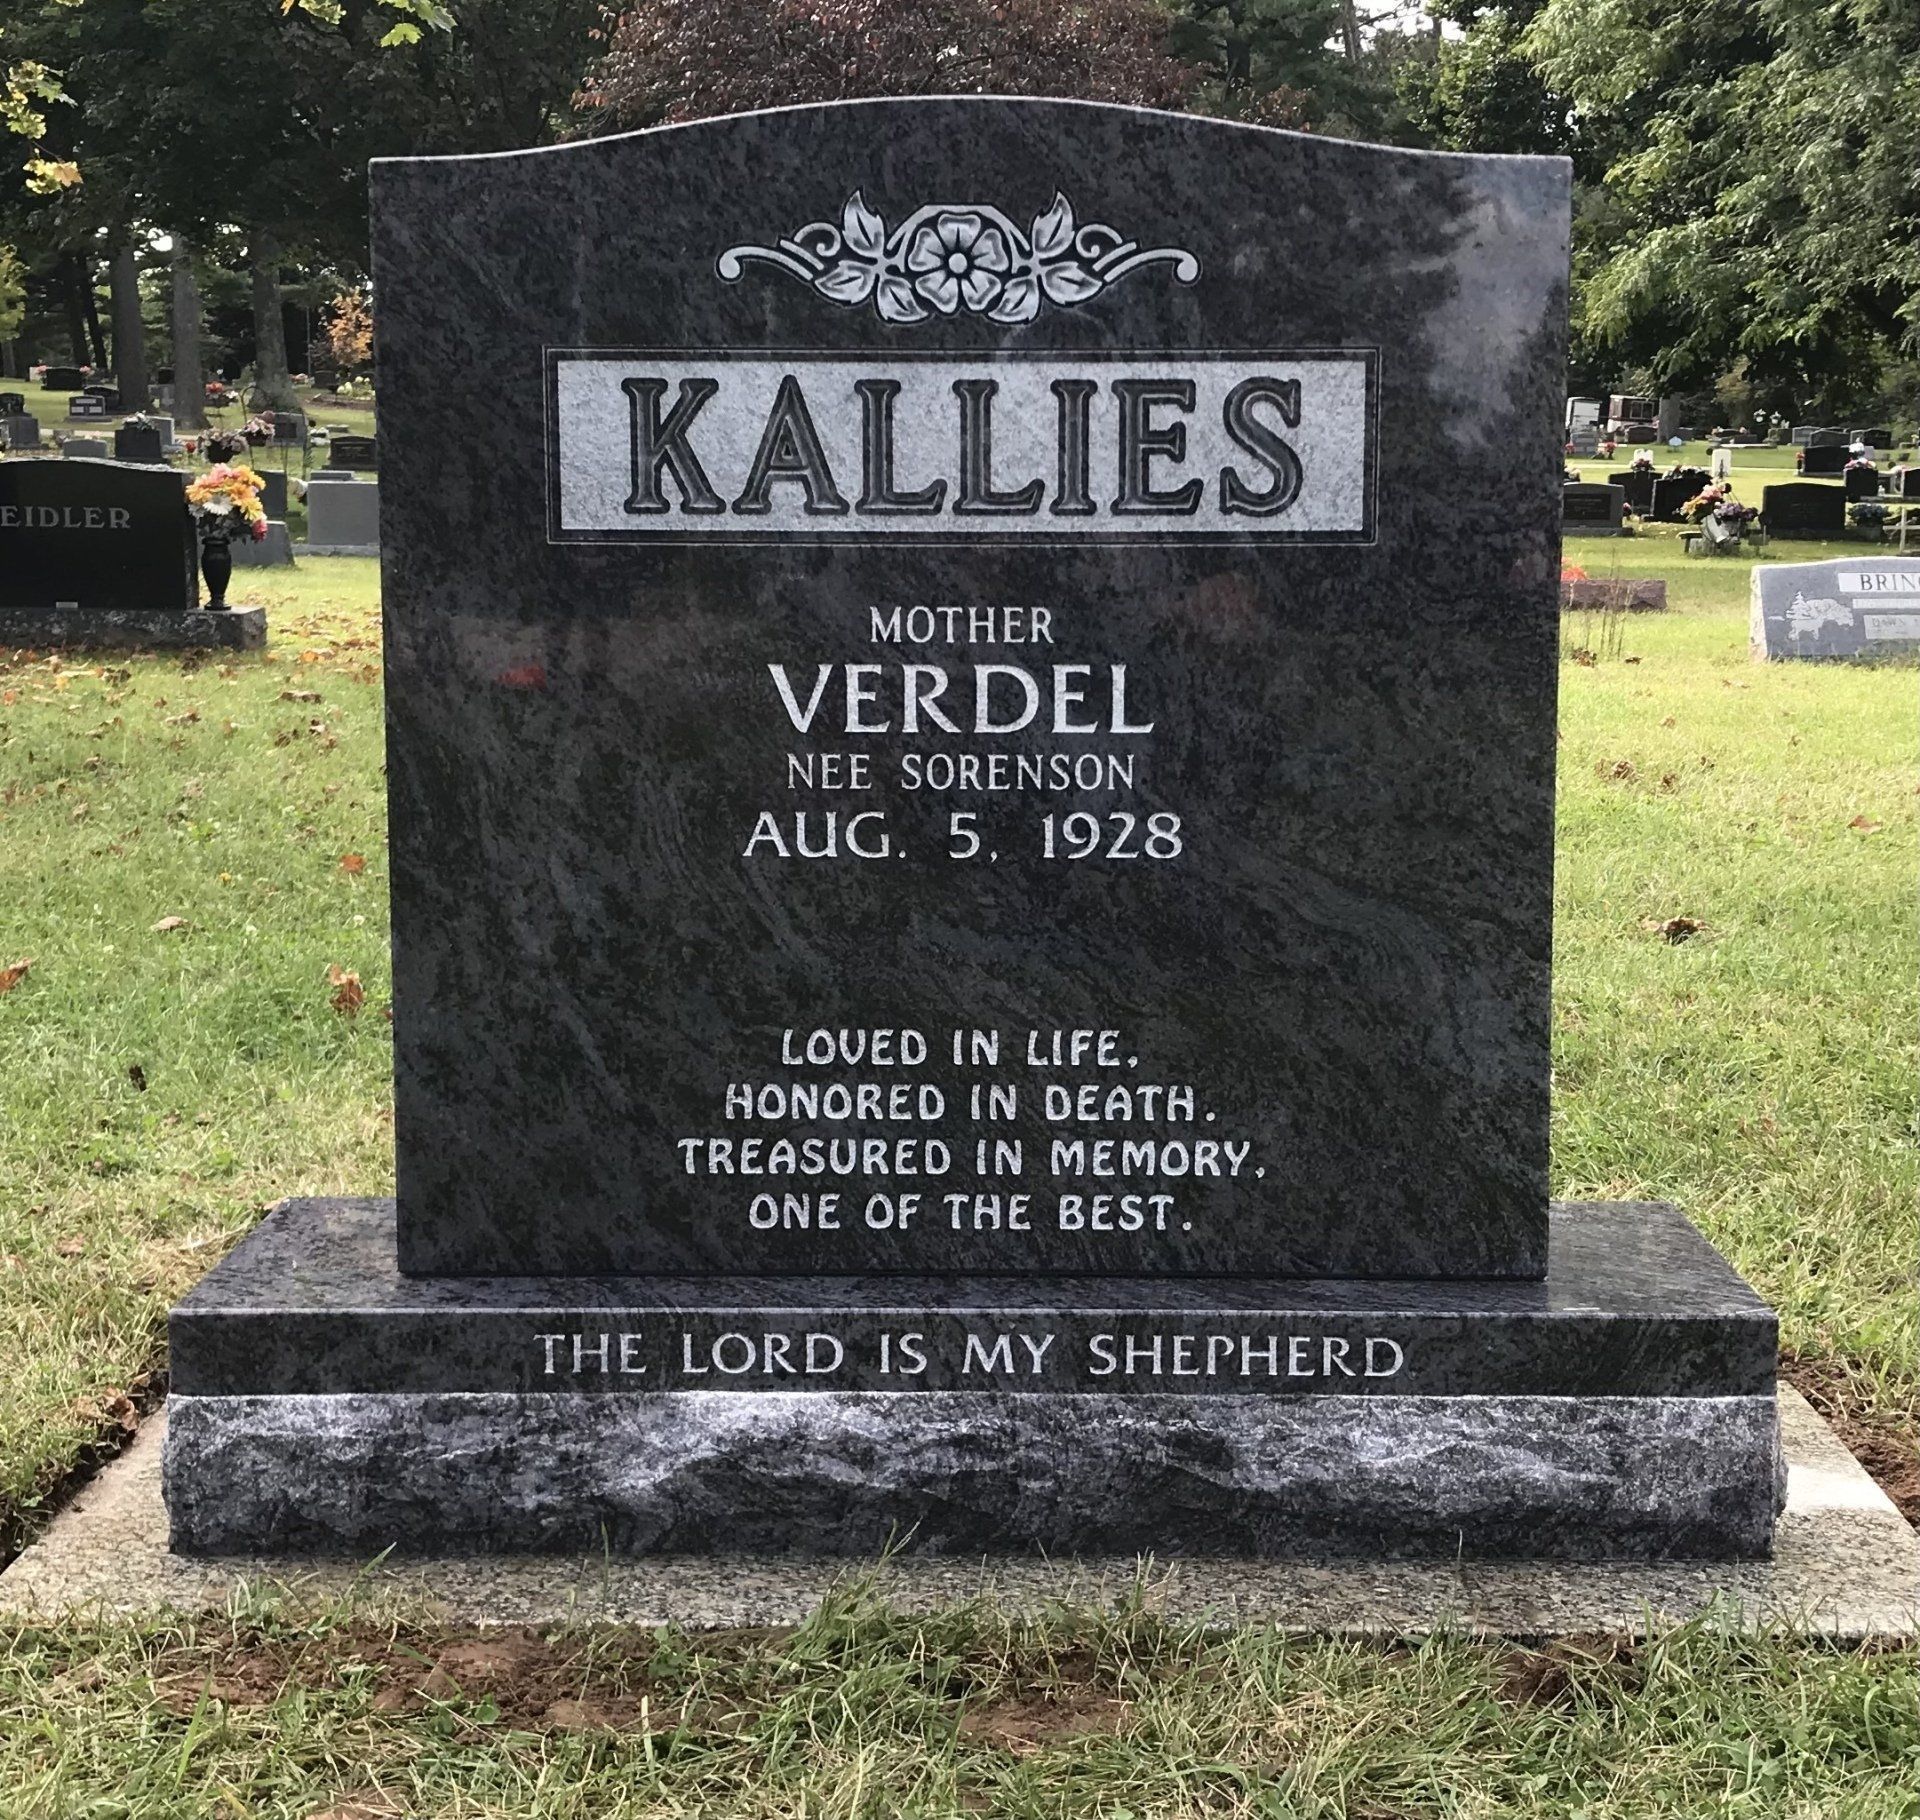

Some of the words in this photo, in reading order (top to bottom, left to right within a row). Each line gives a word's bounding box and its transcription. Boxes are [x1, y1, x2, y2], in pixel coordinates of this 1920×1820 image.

[620, 375, 1304, 517] KALLIES
[1860, 574, 1920, 590] BRIN
[869, 605, 1054, 644] MOTHER
[767, 663, 1155, 734] VERDEL
[786, 753, 872, 790] NEE
[901, 753, 1135, 791] SORENSON
[742, 811, 906, 859] AUG.
[949, 812, 998, 863] 5,
[1041, 811, 1183, 859] 1928
[782, 1028, 927, 1066] LOVED
[953, 1029, 999, 1066] IN
[1027, 1029, 1138, 1069] LIFE,
[725, 1083, 945, 1121] HONORED
[971, 1084, 1017, 1121] IN
[1045, 1084, 1216, 1122] DEATH.
[677, 1137, 951, 1175] TREASURED
[976, 1139, 1022, 1175] IN
[1051, 1139, 1265, 1179] MEMORY,
[749, 1193, 841, 1229] ONE
[865, 1193, 922, 1230] OF
[943, 1193, 1032, 1230] THE
[1059, 1194, 1192, 1231] BEST.
[533, 1333, 647, 1374] THE
[682, 1332, 844, 1374] LORD
[879, 1332, 928, 1374] IS
[961, 1333, 1055, 1374] MY
[1089, 1333, 1404, 1377] SHEPHERD
